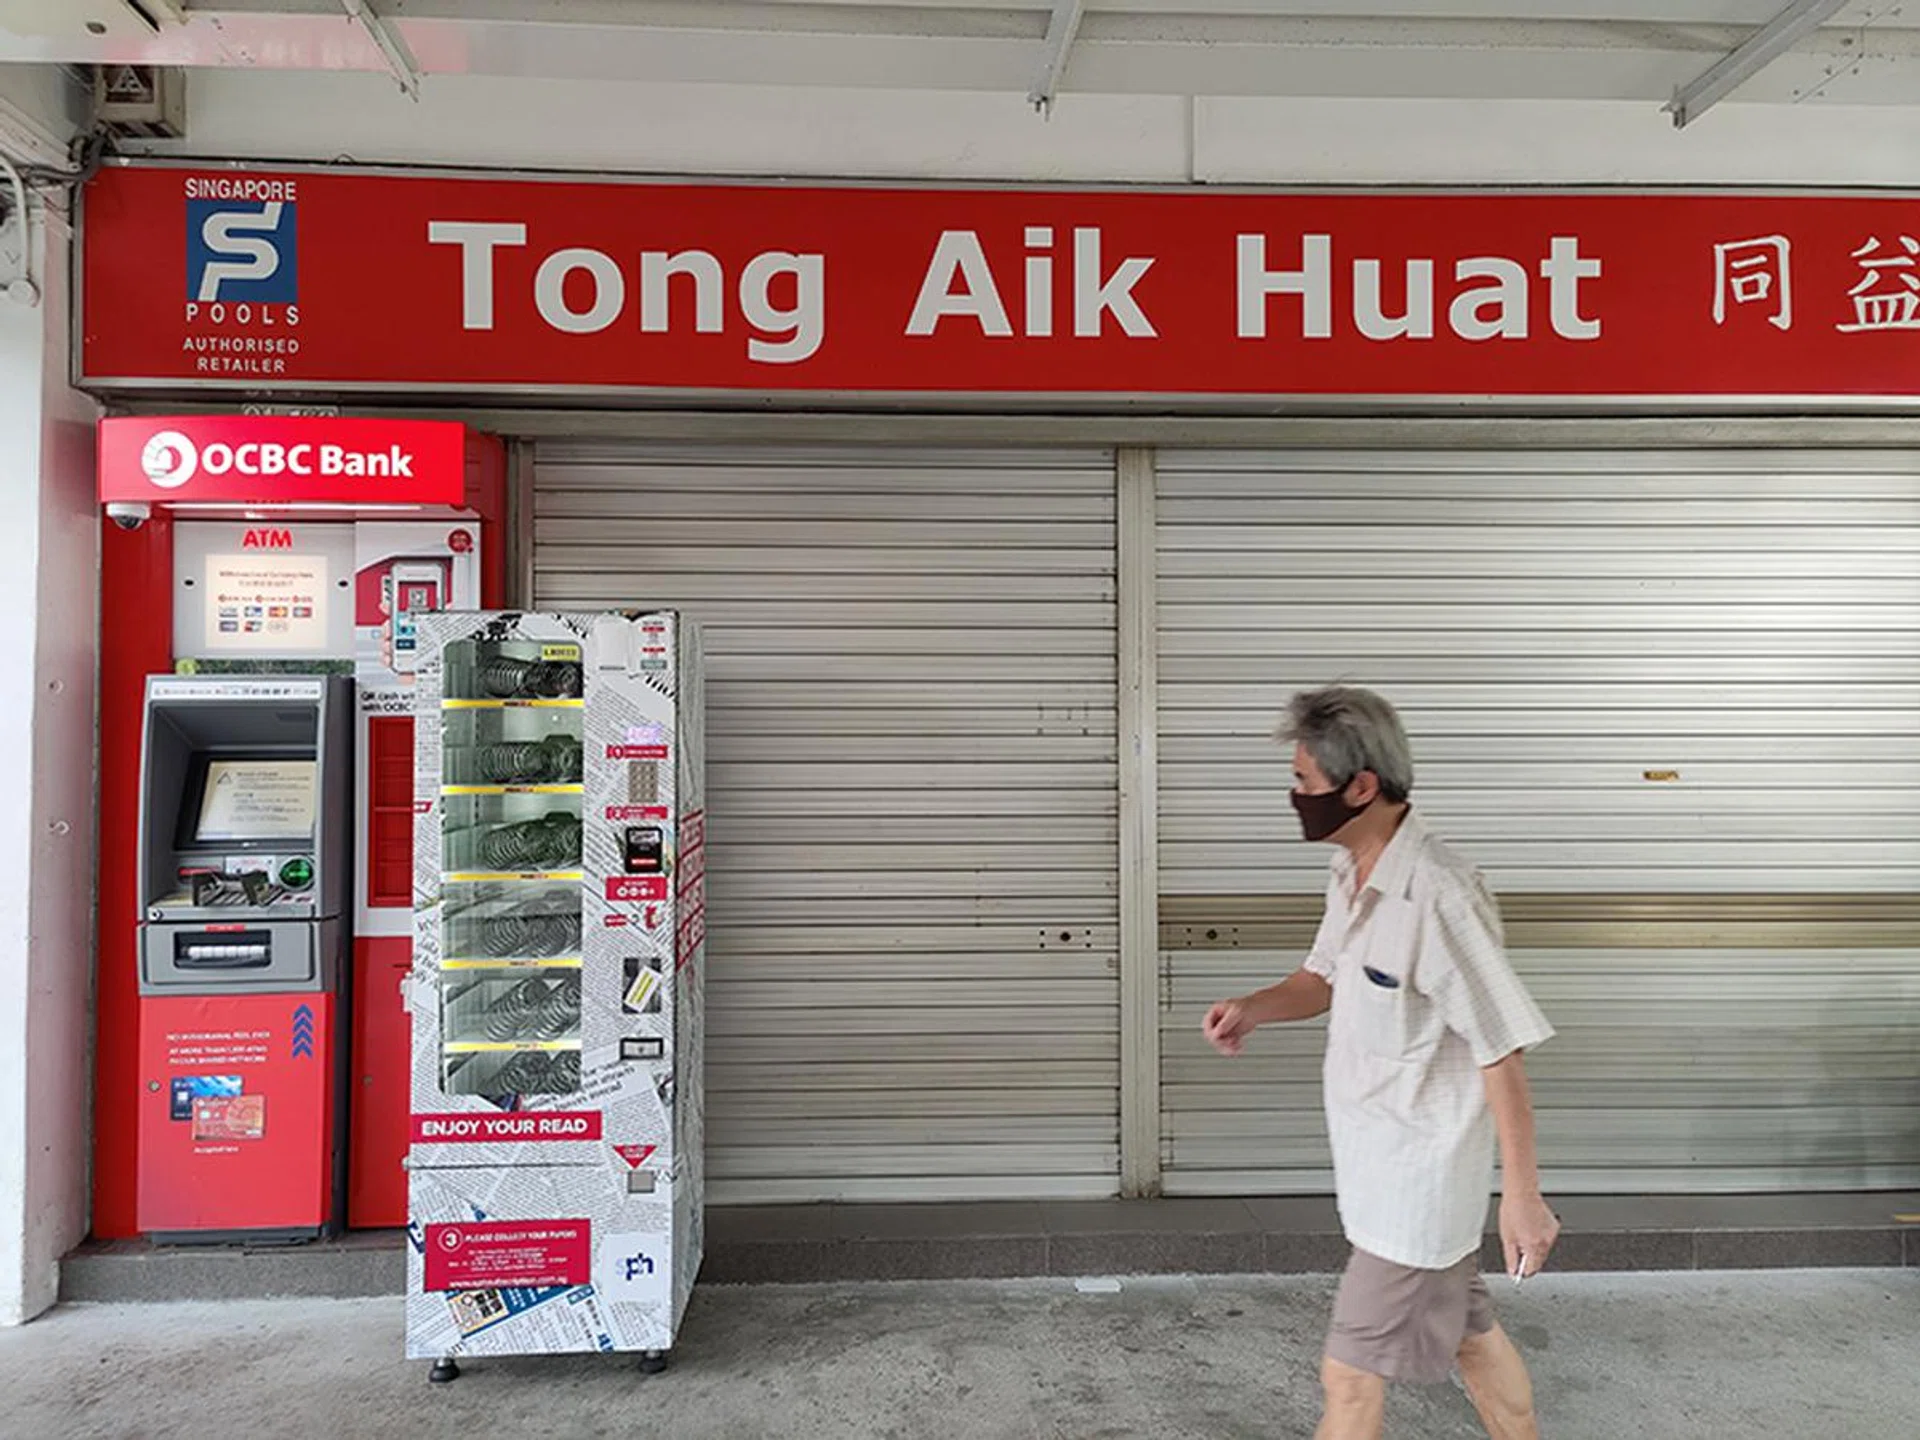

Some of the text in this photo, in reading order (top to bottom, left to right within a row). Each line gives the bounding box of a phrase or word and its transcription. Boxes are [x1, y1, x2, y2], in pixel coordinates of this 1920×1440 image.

[185, 177, 297, 202] SINGAPORE
[428, 221, 1602, 364] Tong Aik Huat
[187, 302, 299, 326] POOLS
[183, 337, 299, 354] AUTHORISED
[197, 357, 285, 373] RETAILER
[202, 443, 413, 477] OCBC Bank
[243, 528, 292, 548] ATM
[422, 1118, 588, 1137] ENJOY YOUR READ
[444, 1232, 457, 1248] 3
[527, 1231, 548, 1240] YOUR
